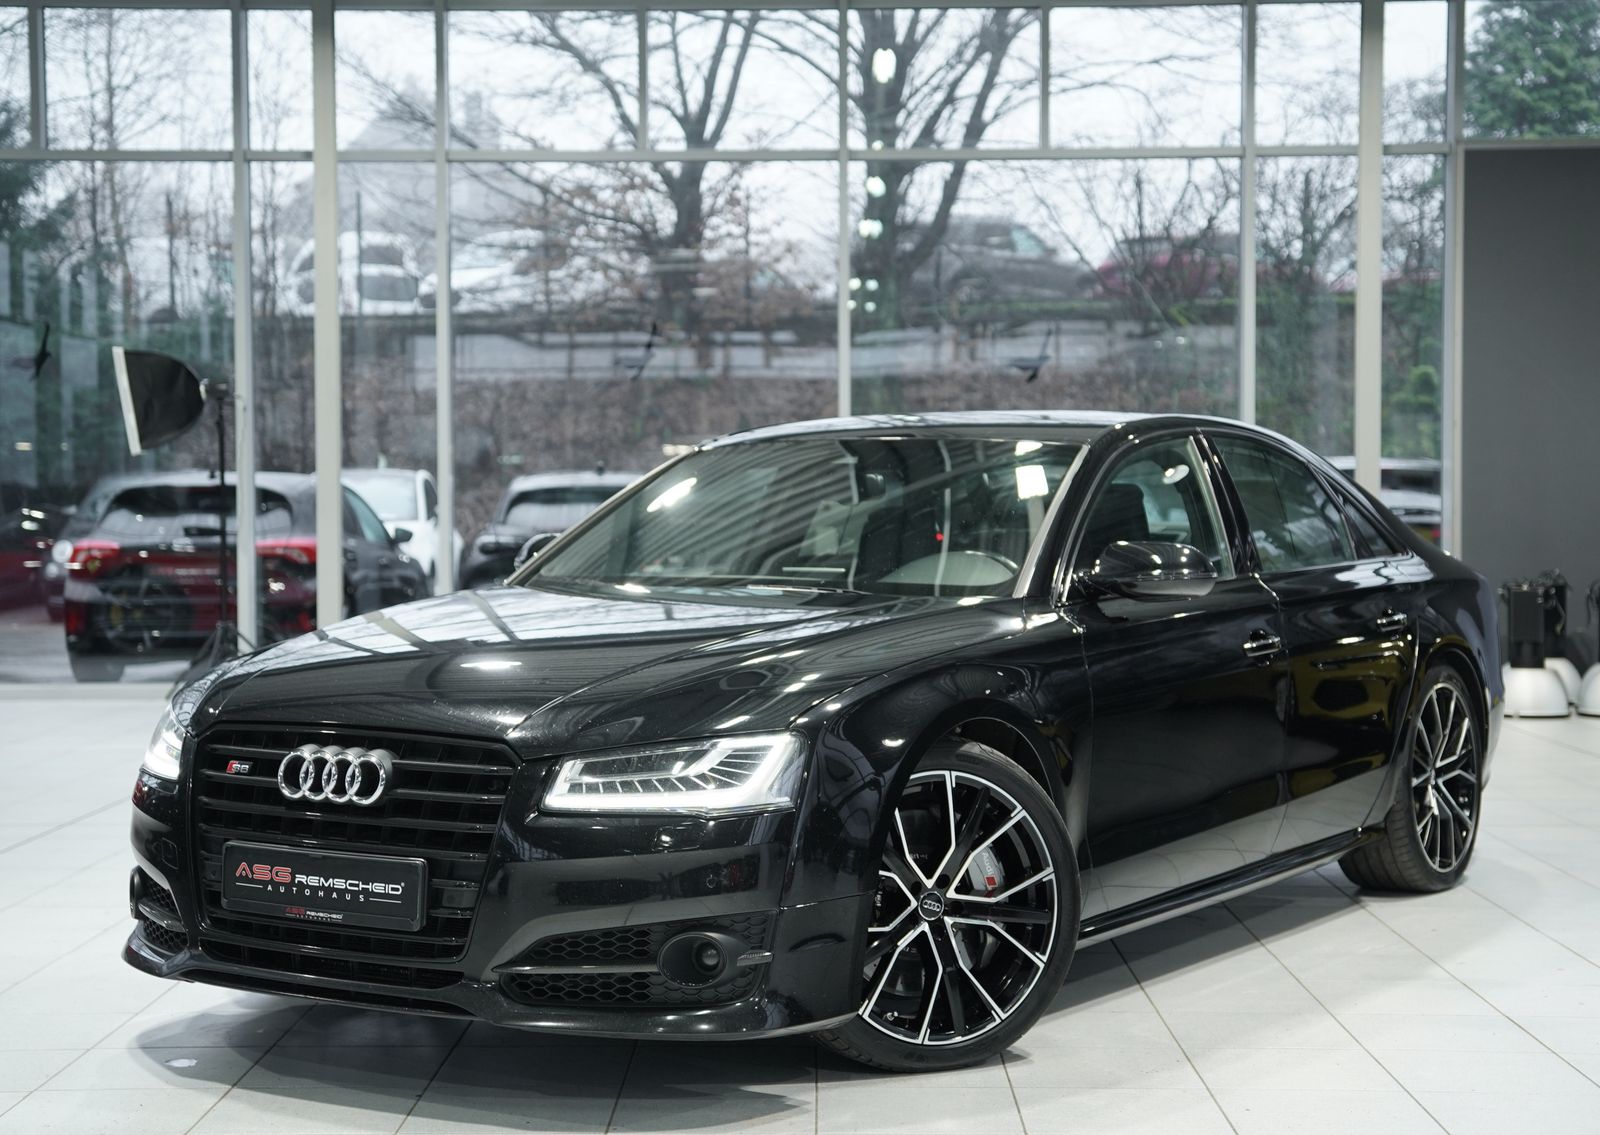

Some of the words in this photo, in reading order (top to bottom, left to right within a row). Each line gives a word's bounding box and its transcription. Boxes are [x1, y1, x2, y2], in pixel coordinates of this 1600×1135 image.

[235, 862, 292, 883] ASG
[982, 852, 995, 875] Audi
[267, 884, 364, 902] AUTOHAUS
